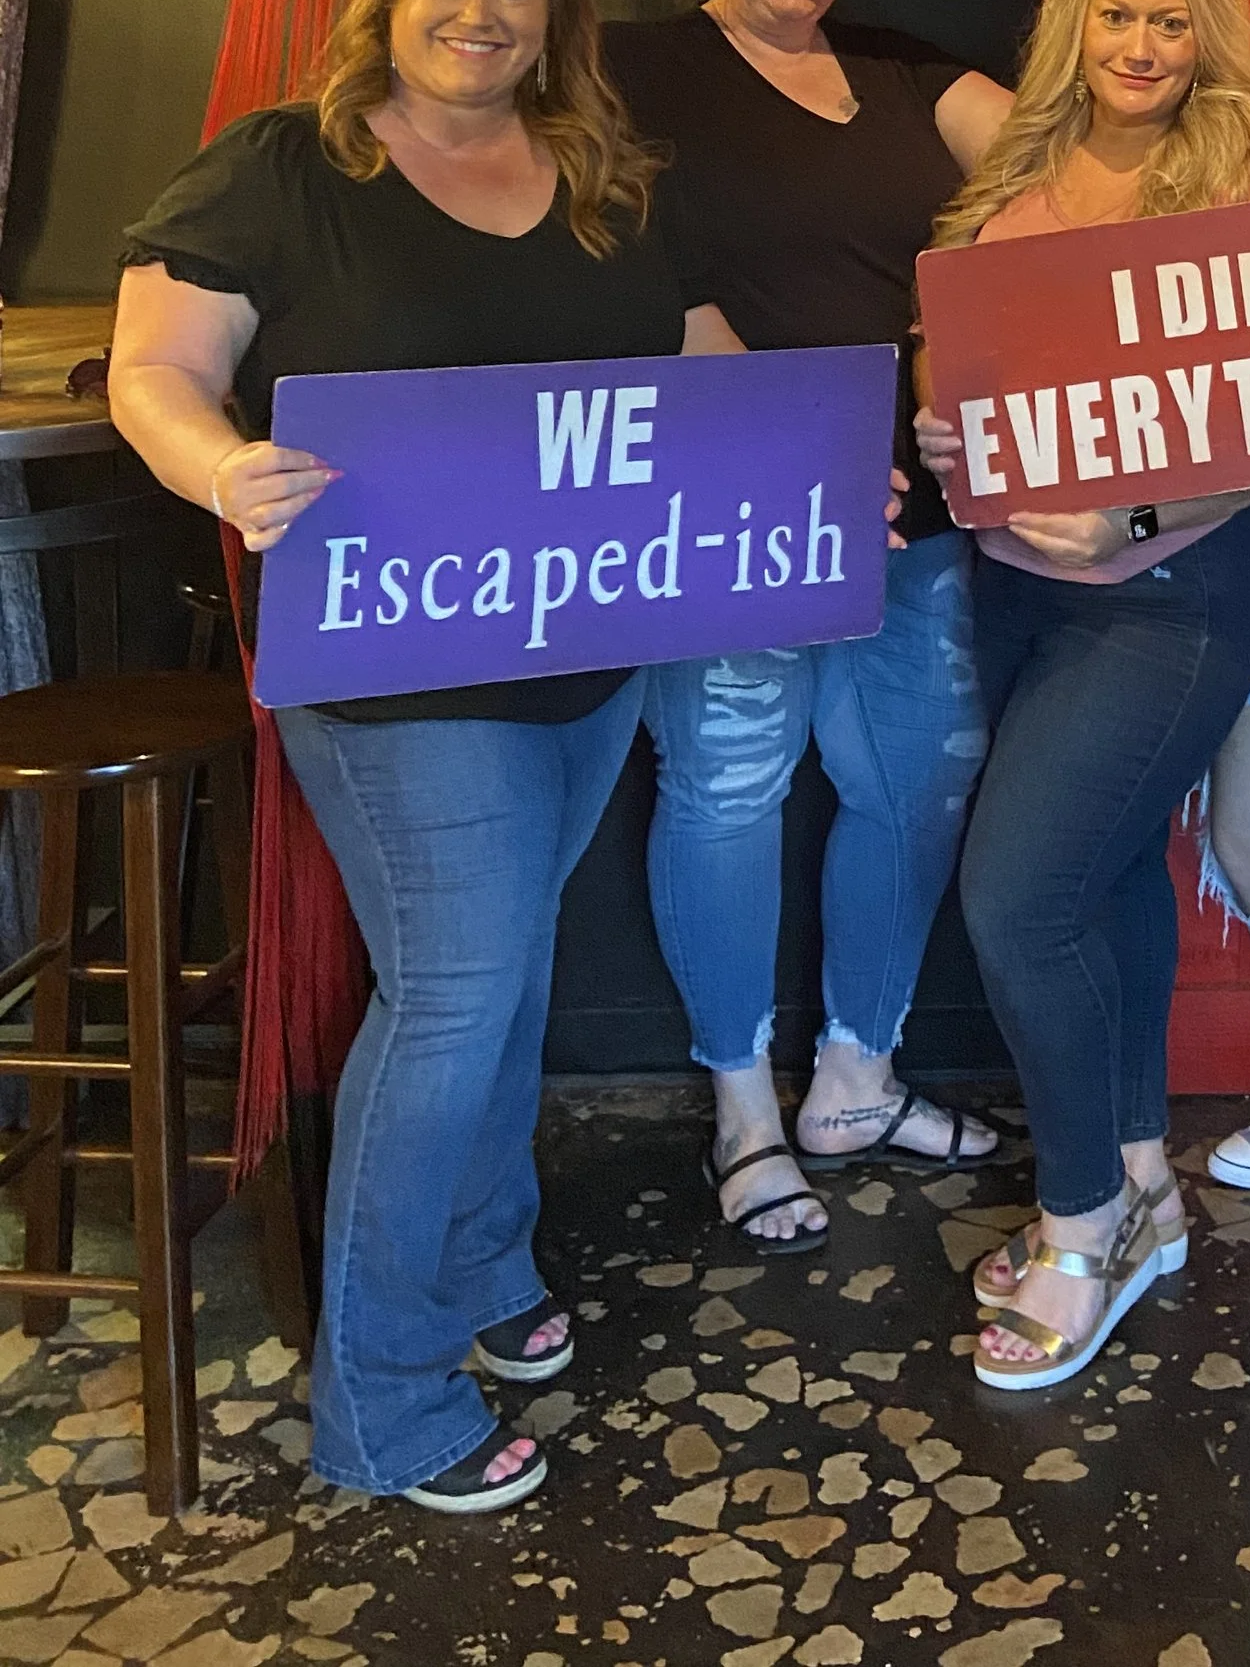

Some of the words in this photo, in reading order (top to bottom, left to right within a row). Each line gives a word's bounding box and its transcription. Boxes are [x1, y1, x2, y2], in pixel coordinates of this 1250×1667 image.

[1111, 270, 1139, 344] I
[537, 386, 657, 491] WE
[319, 482, 845, 649] Escaped-ish
